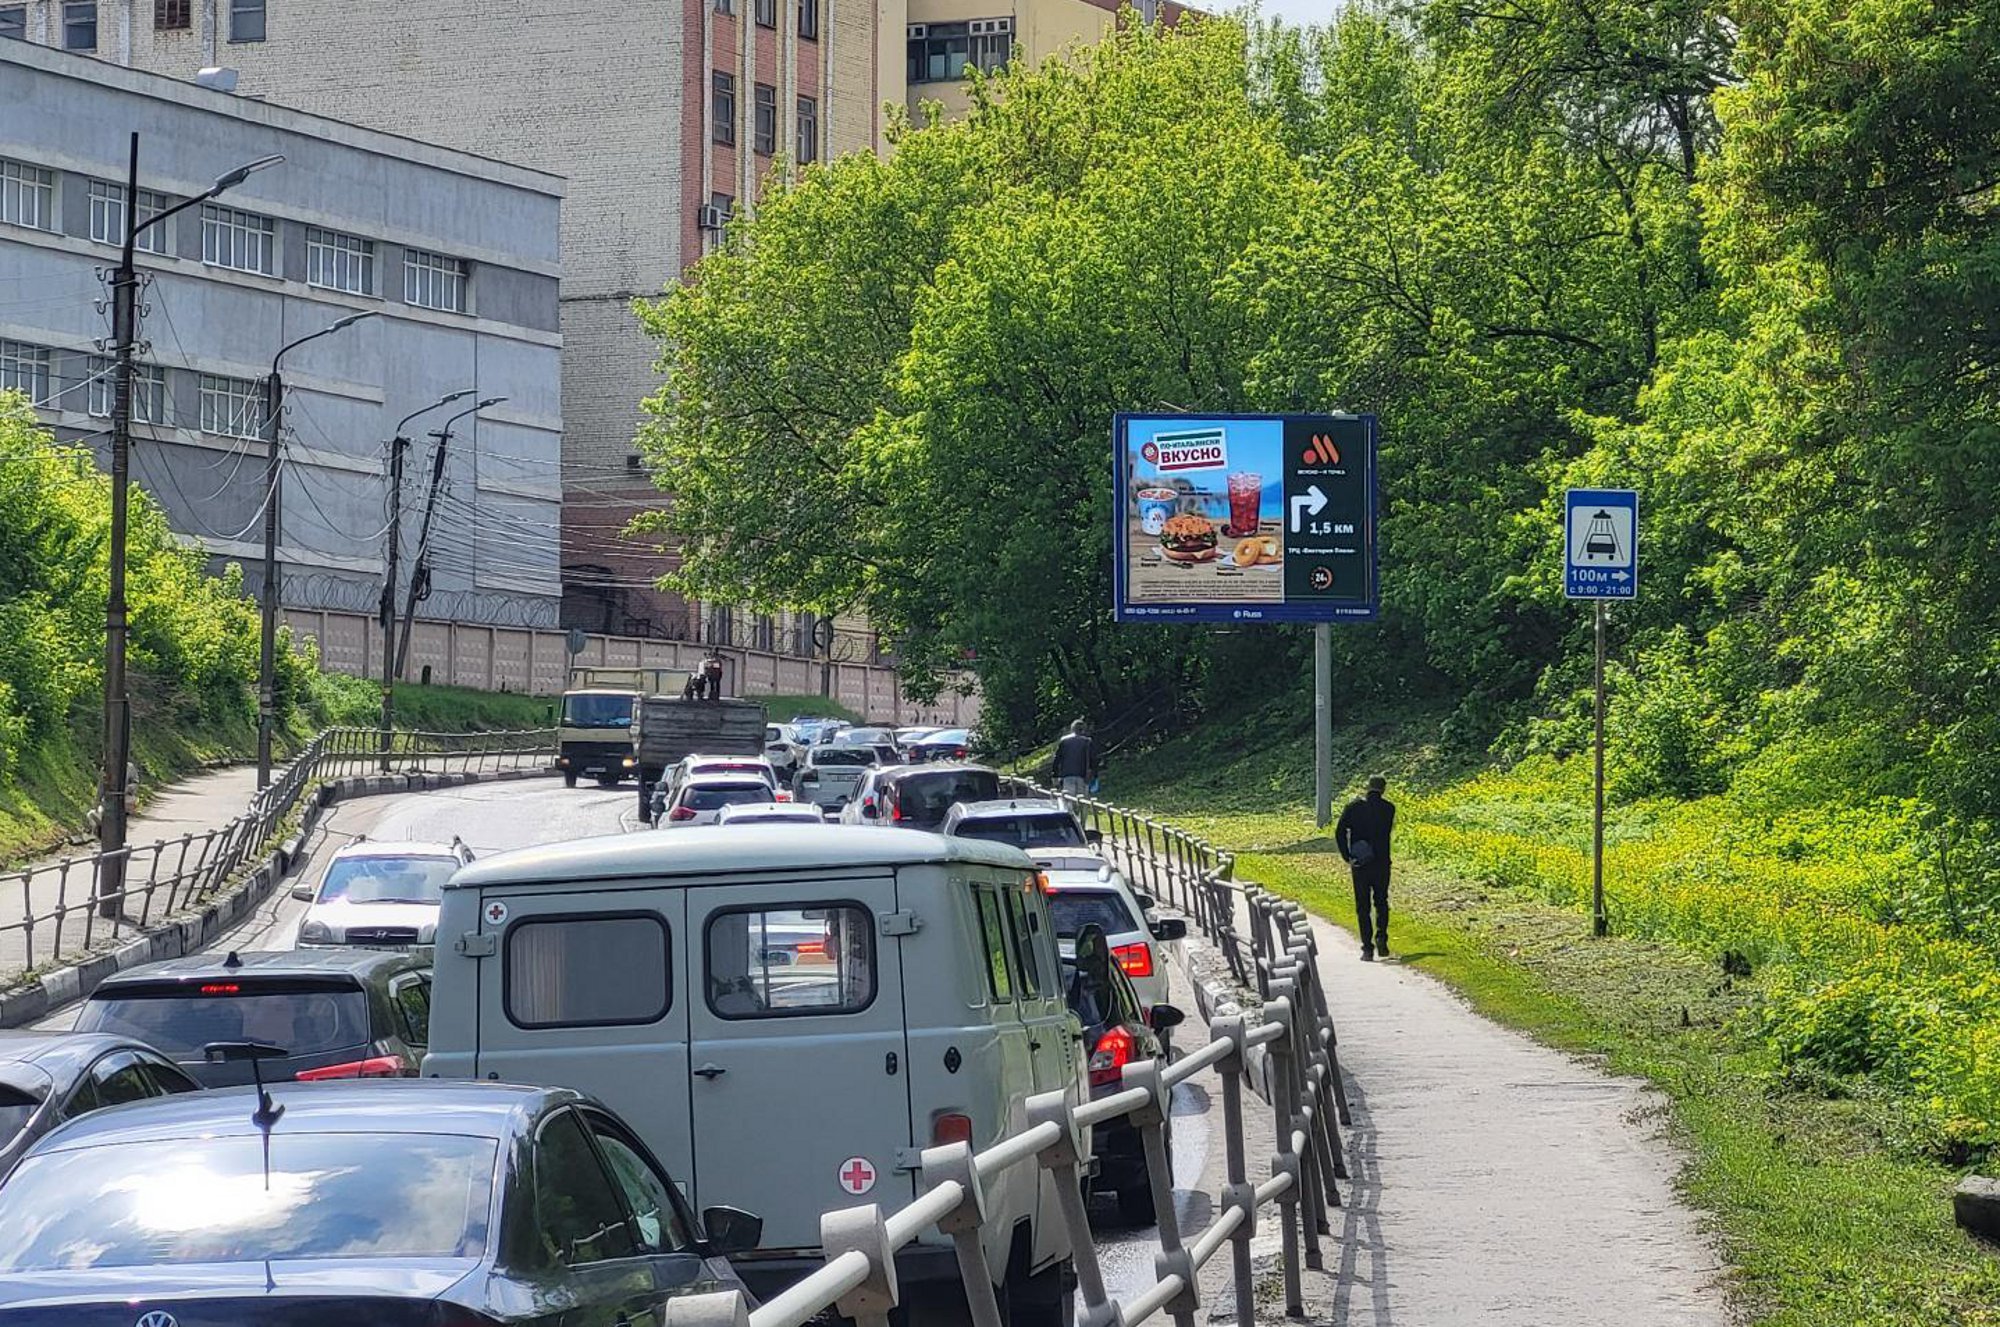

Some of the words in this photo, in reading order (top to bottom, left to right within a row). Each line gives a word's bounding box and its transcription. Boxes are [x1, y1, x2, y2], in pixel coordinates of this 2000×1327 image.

[1160, 439, 1220, 449] ПО-ИТАЛЬЯНСКИ
[1161, 447, 1221, 463] ВКУСНО
[1309, 522, 1331, 536] 1,5
[1288, 547, 1301, 555] ТРЦ
[1577, 586, 1598, 594] 9:00
[1606, 586, 1631, 595] 21:00
[1243, 610, 1262, 618] Russ
